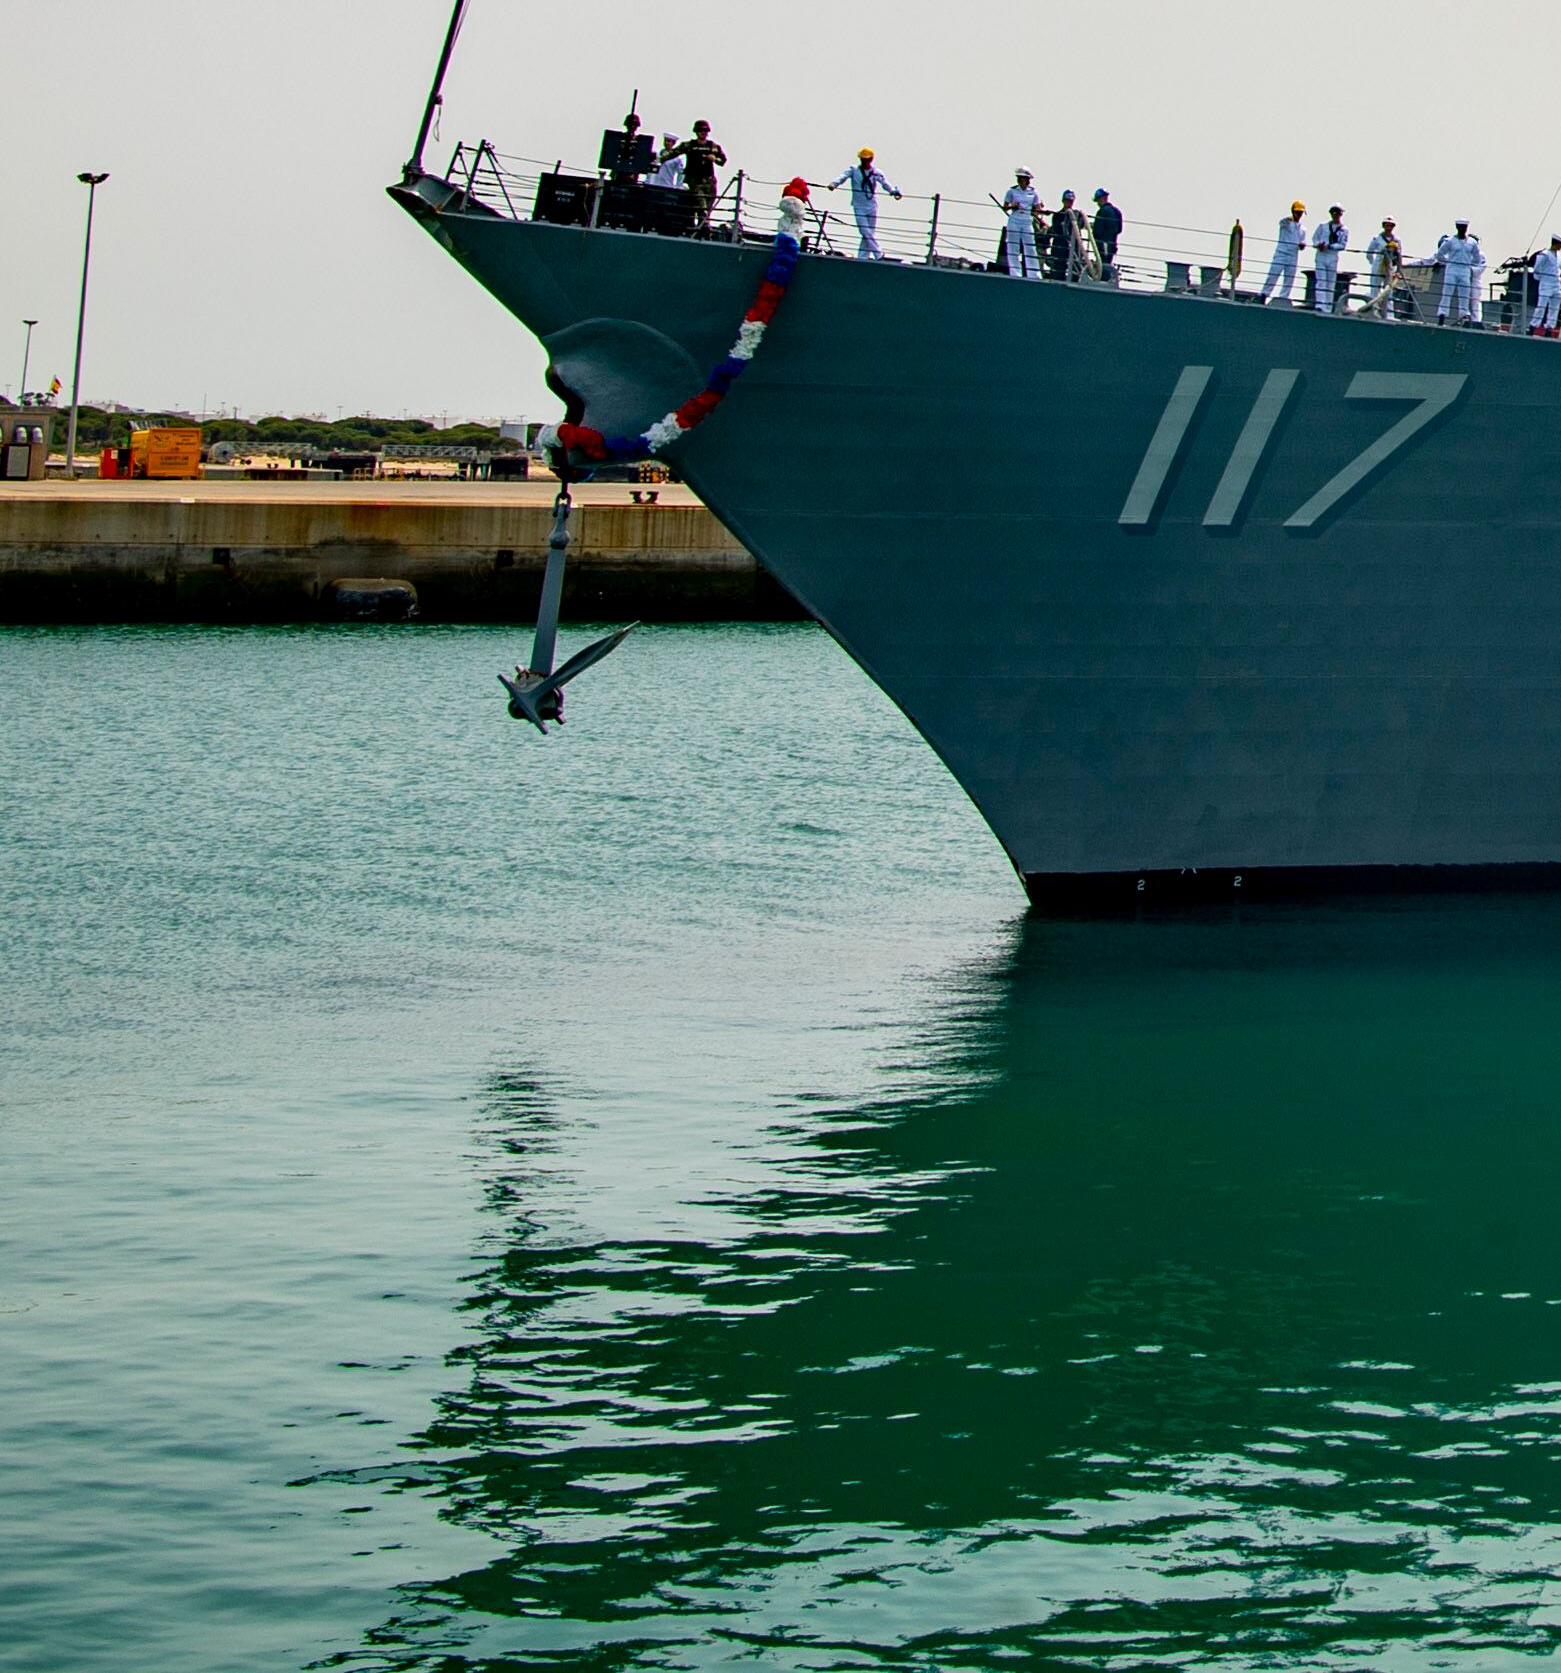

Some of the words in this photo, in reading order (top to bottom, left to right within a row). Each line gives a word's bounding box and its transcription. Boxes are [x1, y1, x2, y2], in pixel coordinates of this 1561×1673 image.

[1117, 365, 1469, 527] 117
[1137, 879, 1146, 891] 2
[1233, 875, 1242, 887] 2
